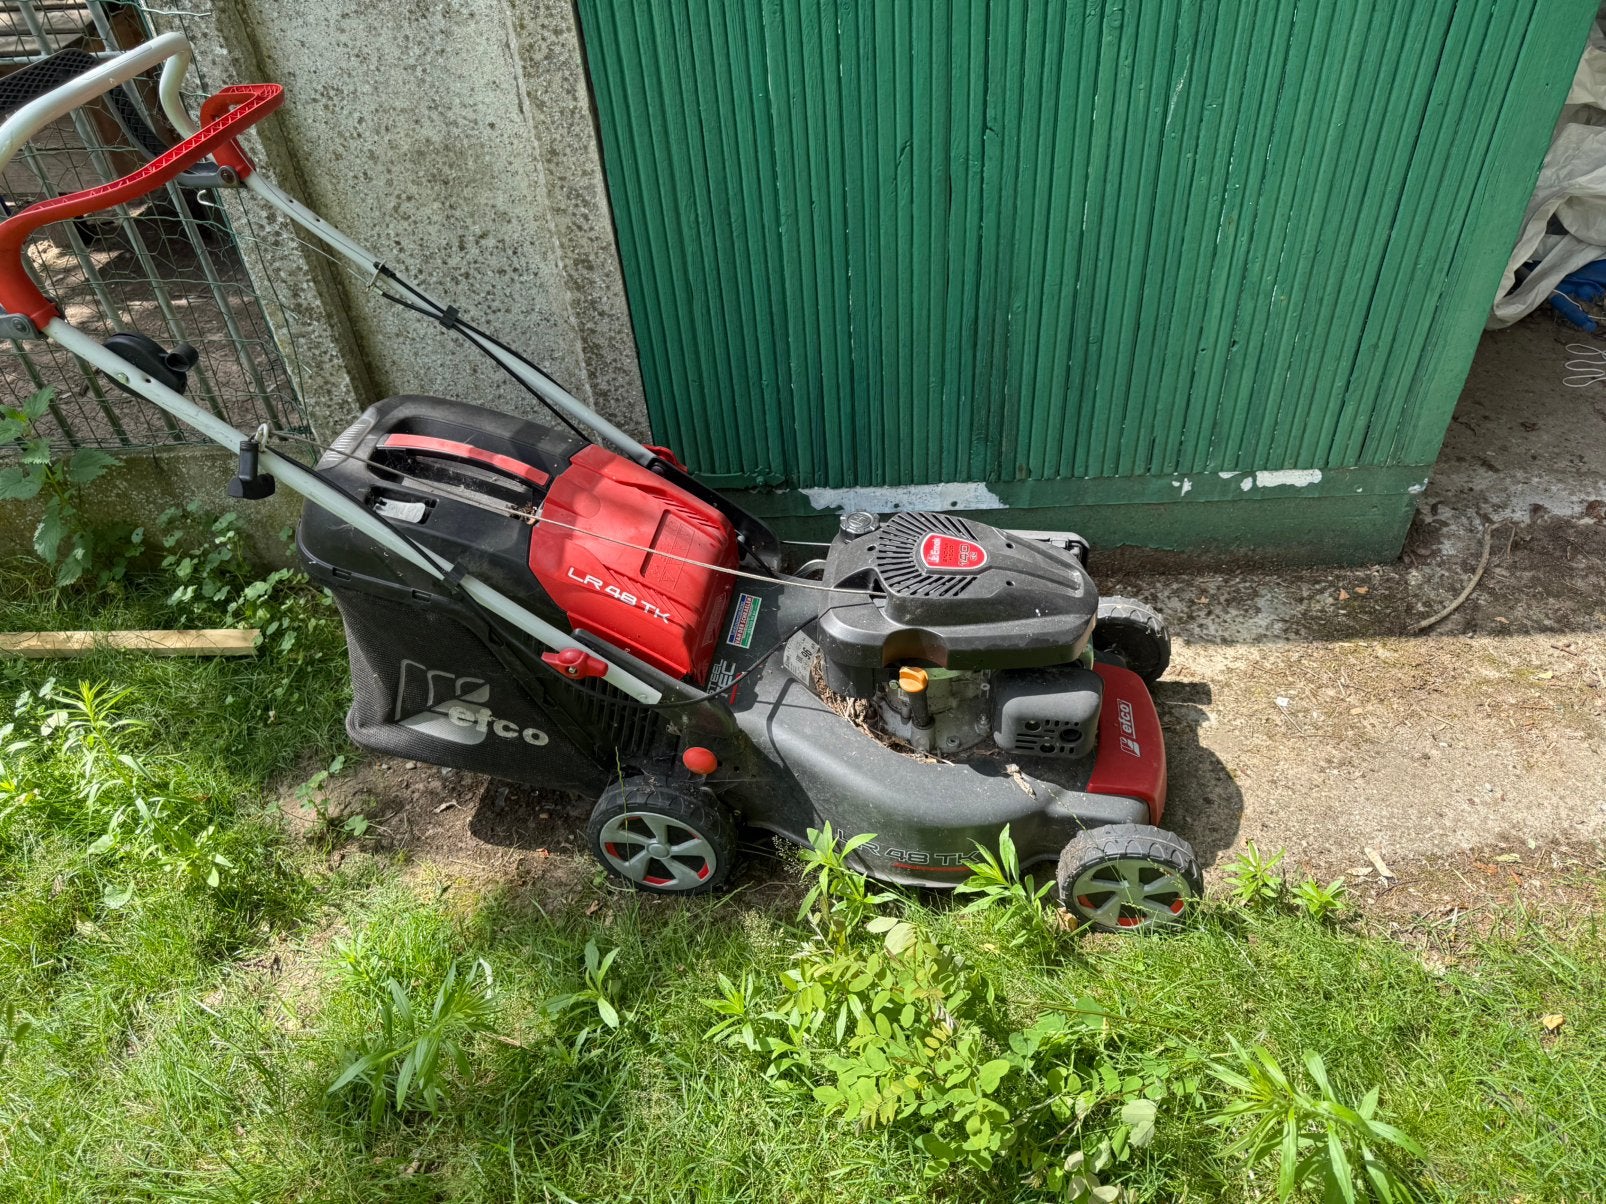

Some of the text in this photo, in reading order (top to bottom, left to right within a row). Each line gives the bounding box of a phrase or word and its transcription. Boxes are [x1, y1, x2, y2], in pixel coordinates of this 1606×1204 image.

[957, 544, 970, 566] 140
[567, 567, 671, 624] LR 48 TK
[734, 632, 742, 645] VAN
[801, 647, 812, 660] 96
[707, 659, 723, 694] STEEL
[448, 706, 549, 746] efco
[1120, 703, 1132, 734] efco
[885, 847, 930, 864] 48
[934, 850, 980, 866] TK
